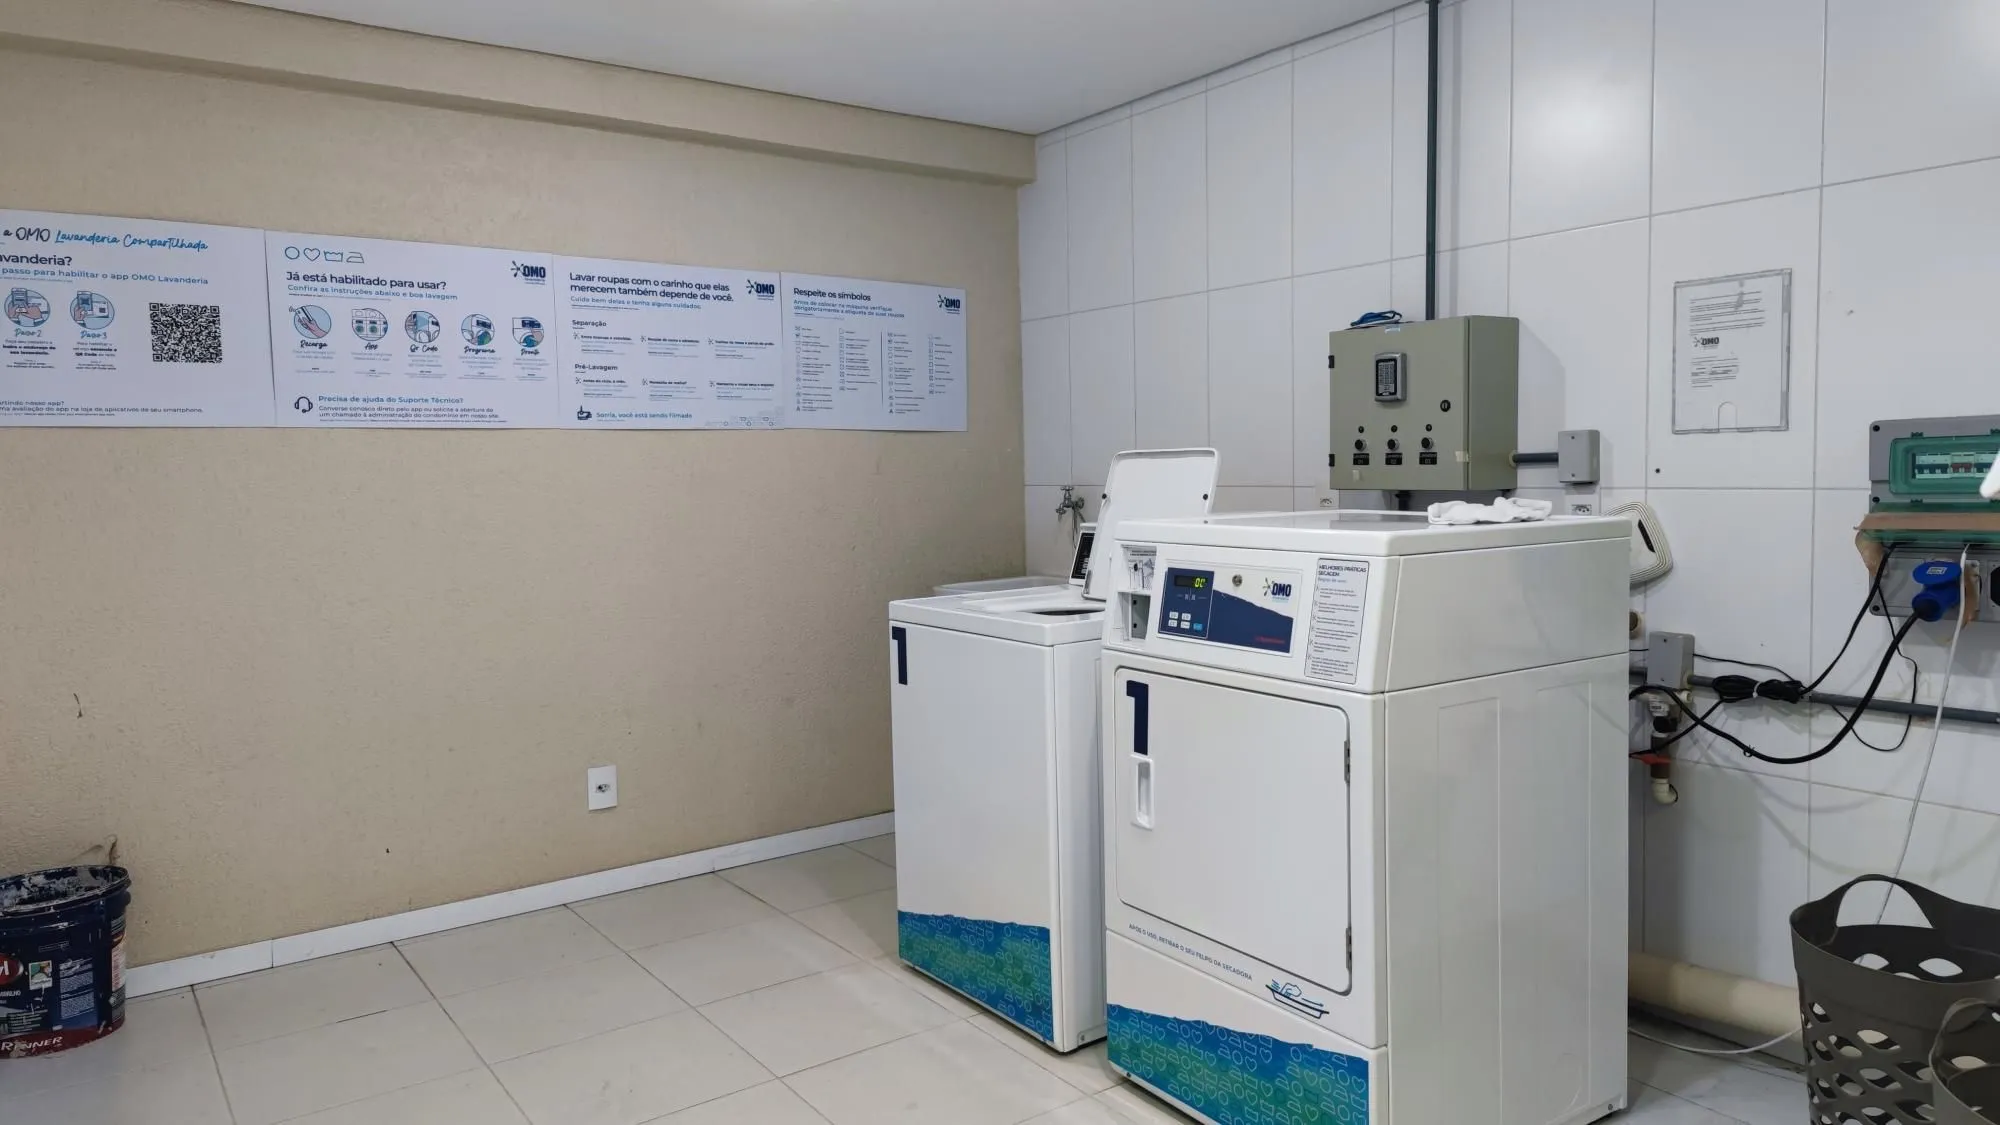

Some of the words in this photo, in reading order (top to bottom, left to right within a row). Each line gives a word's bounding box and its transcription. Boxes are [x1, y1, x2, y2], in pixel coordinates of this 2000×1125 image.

[15, 227, 51, 242] OMO
[54, 230, 120, 245] Lavanderia
[2, 267, 31, 276] passo
[33, 268, 56, 278] para
[58, 269, 99, 279] habilitar
[110, 273, 129, 281] app
[131, 274, 156, 282] OMO
[158, 275, 209, 285] Lavanderia
[286, 271, 300, 281] Já
[302, 273, 327, 283] está
[330, 274, 387, 287] habilitado
[390, 279, 415, 289] para
[417, 280, 447, 290] usar?
[523, 265, 546, 279] OMO
[570, 272, 595, 282] Lavar
[597, 275, 630, 286] roupas
[631, 278, 651, 287] com
[661, 278, 694, 289] carinho
[695, 282, 711, 292] que
[713, 282, 730, 291] elas
[756, 283, 775, 295] OMO
[287, 284, 317, 292] Confira
[331, 286, 373, 295] instruções
[375, 289, 400, 297] abaixo
[425, 292, 458, 301] lavagem
[570, 284, 617, 294] merecem
[618, 285, 657, 297] também
[659, 288, 698, 300] depende
[700, 291, 710, 300] de
[712, 292, 734, 302] você.
[793, 288, 827, 298] Respeite
[838, 291, 871, 301] símbolos
[945, 298, 960, 309] OMO
[572, 319, 607, 328] Separação
[1701, 336, 1720, 346] OMO
[574, 363, 618, 372] Pré-Lavagem
[1271, 582, 1292, 597] OMO
[891, 626, 908, 686] 1
[1126, 680, 1149, 756] 1
[1222, 963, 1253, 981] SECADORA
